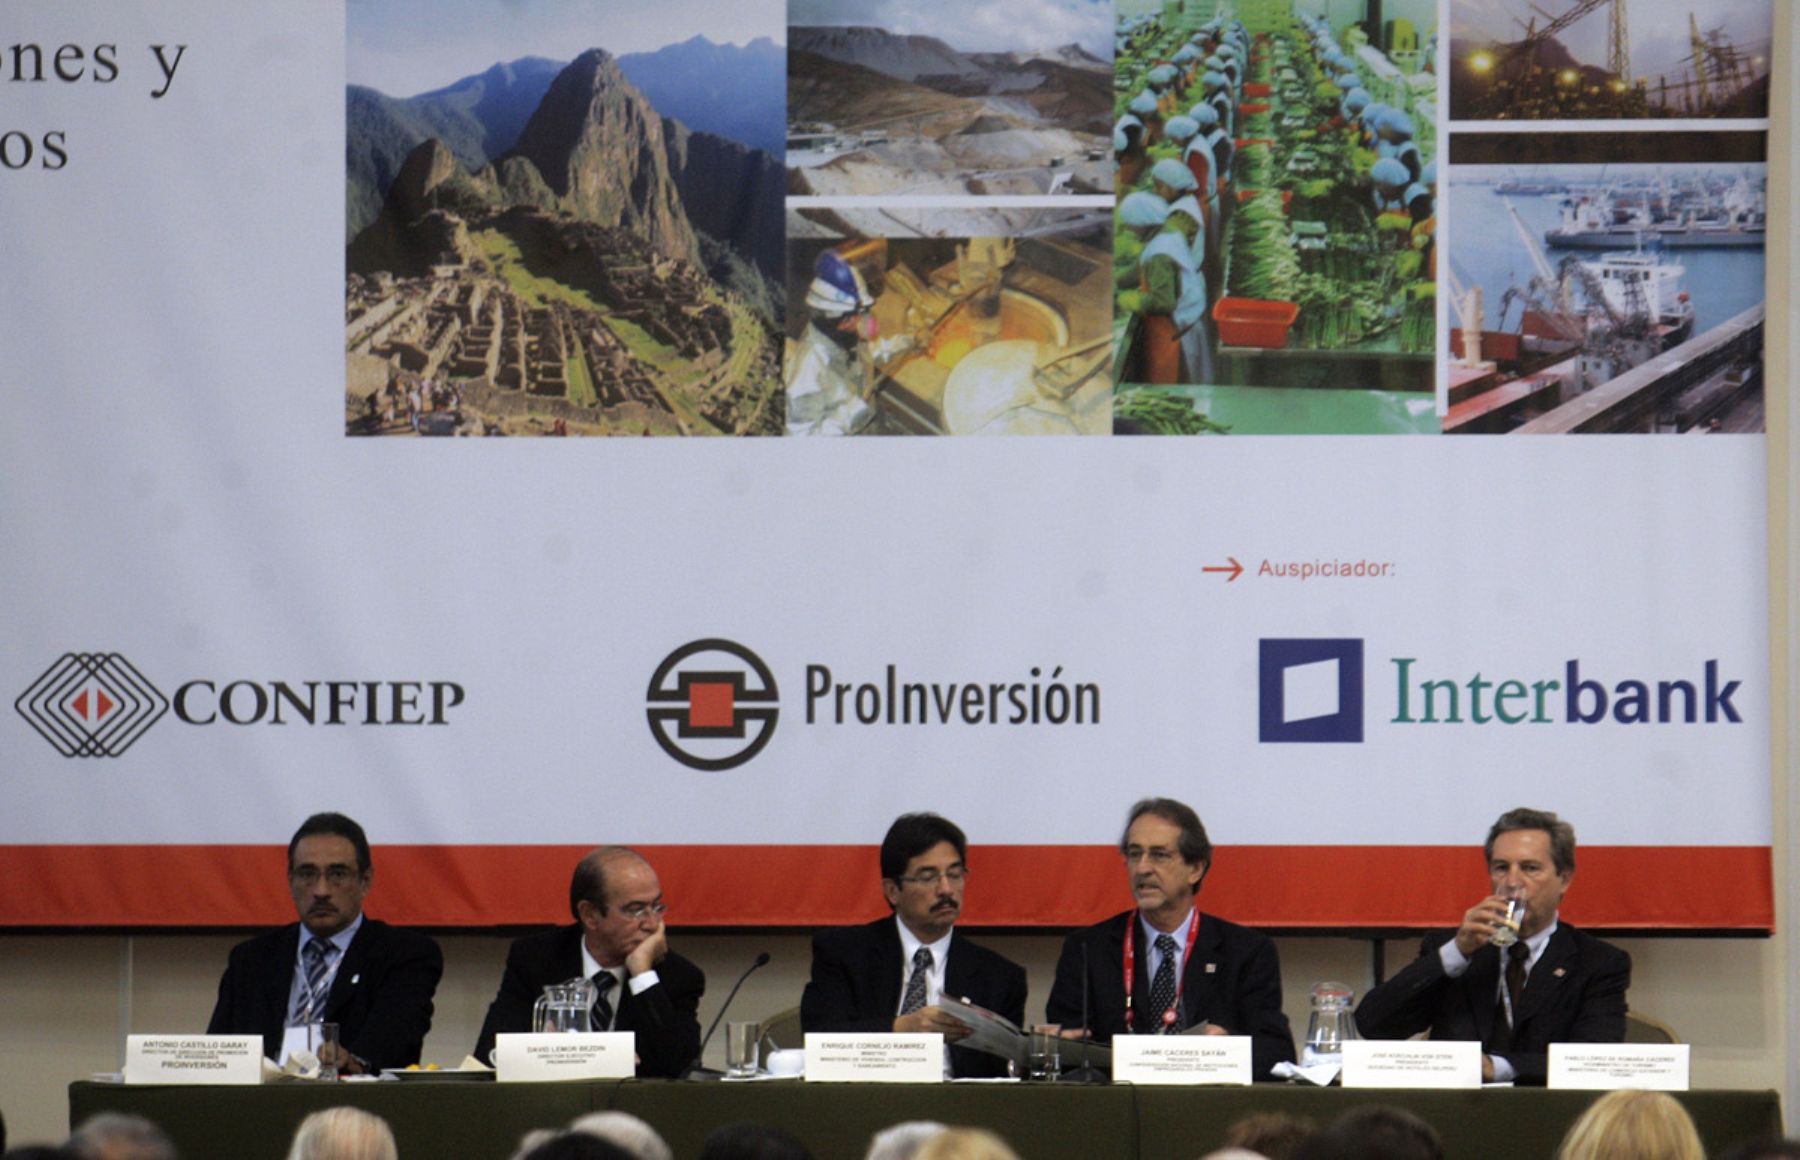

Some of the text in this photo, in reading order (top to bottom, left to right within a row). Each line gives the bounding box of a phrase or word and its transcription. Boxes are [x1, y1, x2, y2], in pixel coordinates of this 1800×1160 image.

[0, 44, 188, 99] nes y
[1258, 559, 1395, 581] Auspiciador:
[172, 680, 465, 725] CONFIEP
[806, 664, 1099, 725] ProInversión
[1390, 657, 1743, 724] Interbank
[143, 1040, 248, 1049] ANTONIO CASTILLO GARAY
[527, 1046, 550, 1054] DAVID
